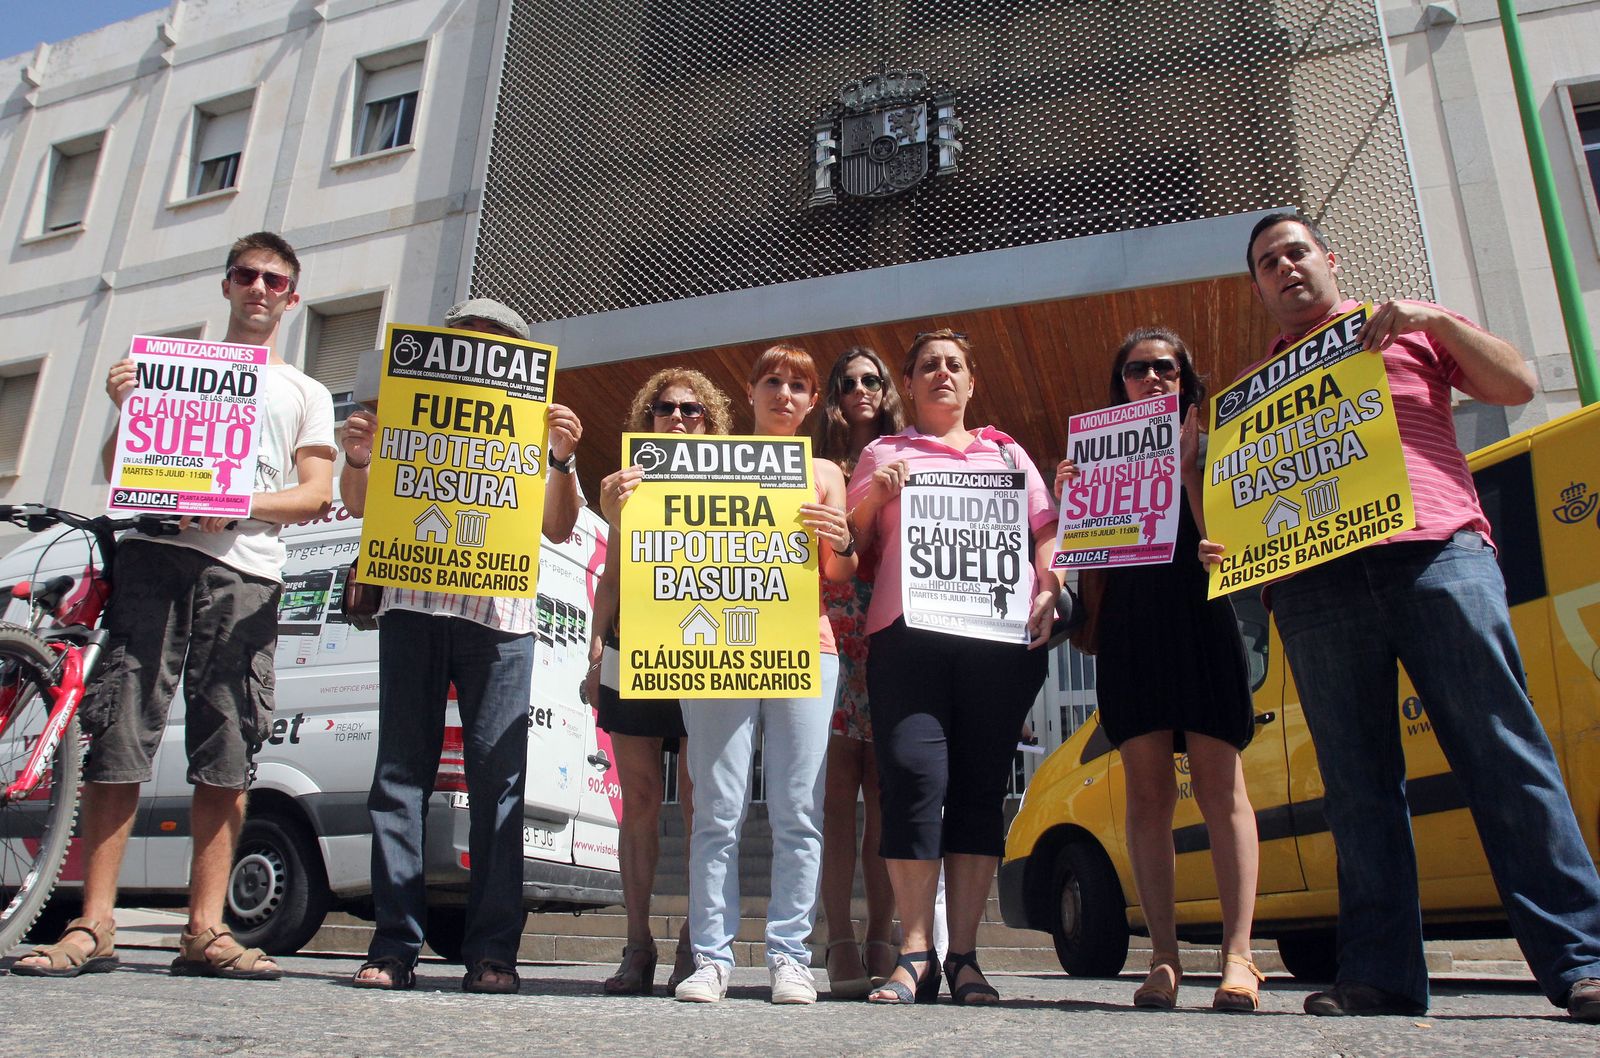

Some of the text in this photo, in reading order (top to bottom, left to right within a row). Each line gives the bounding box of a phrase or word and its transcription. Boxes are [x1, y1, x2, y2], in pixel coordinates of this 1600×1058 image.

[146, 340, 254, 362] MOVILIZACIONES
[424, 336, 548, 384] ADICAE
[1246, 314, 1362, 404] ADICAE
[135, 362, 257, 397] NULIDAD
[232, 363, 247, 371] POR
[128, 393, 256, 425] CLÁUSULAS
[224, 396, 256, 405] ABUSIVAS
[508, 391, 545, 402] www.adicae.net
[1239, 374, 1342, 444] FUERA
[412, 392, 515, 437] FUERA
[1080, 400, 1166, 430] MOVILIZACIONES
[1149, 414, 1172, 426] POR LA
[126, 415, 252, 460] SUELO
[380, 428, 541, 476] HIPOTECAS
[1074, 423, 1172, 464] NULIDAD
[1212, 390, 1384, 486] HIPOTECAS
[144, 454, 203, 468] HIPOTECAS
[670, 443, 802, 474] ADICAE
[1146, 448, 1174, 460] ABUSIVAS
[123, 467, 153, 476] MARTES
[164, 469, 185, 478] JULIO
[916, 473, 1012, 487] MOVILIZACIONES
[1068, 456, 1175, 489] CLÁUSULAS
[1231, 430, 1368, 509] BASURA
[127, 492, 178, 505] ADICAE
[395, 465, 518, 509] BASURA
[1066, 476, 1172, 520] SUELO
[664, 495, 776, 526] FUERA
[910, 495, 1019, 523] NULIDAD
[1081, 515, 1132, 528] HIPOTECAS
[631, 530, 809, 564] HIPOTECAS
[908, 522, 1021, 551] CLÁUSULAS
[1064, 531, 1089, 539] MARTES
[1220, 494, 1400, 574] CLÁUSULAS SUELO
[287, 542, 359, 560] arget-pap
[369, 537, 529, 572] CLÁUSULAS SUELO
[910, 544, 1020, 584] SUELO
[1066, 550, 1109, 562] ADICAE
[1219, 513, 1404, 590] ABUSOS BANCARIOS
[366, 561, 528, 591] ABUSOS BANCARIOS
[540, 558, 585, 585] et-paper.com
[654, 567, 788, 601] BASURA
[928, 580, 981, 592] HIPOTECAS
[912, 591, 938, 599] MARTES
[922, 613, 965, 626] ADICAE
[631, 645, 810, 669] CLÁUSULAS SUELO
[632, 673, 811, 691] ABUSOS BANCARIOS
[336, 723, 363, 731] READY
[347, 732, 372, 741] PRINT
[588, 777, 605, 794] 902
